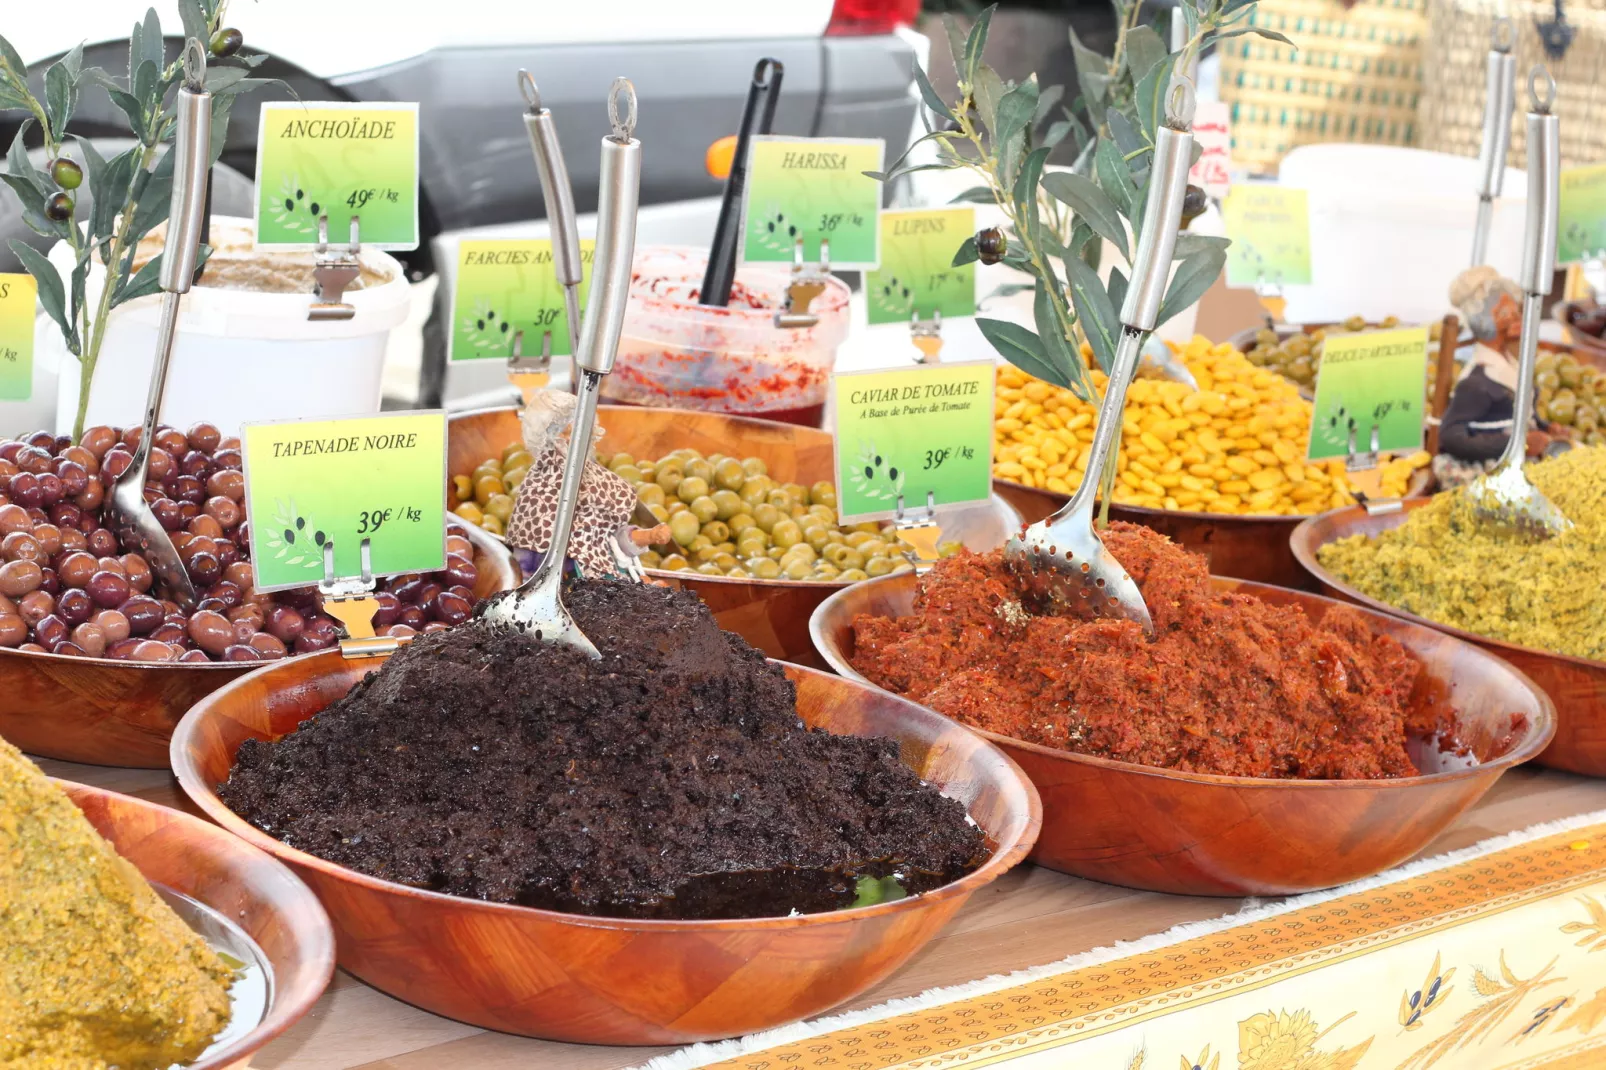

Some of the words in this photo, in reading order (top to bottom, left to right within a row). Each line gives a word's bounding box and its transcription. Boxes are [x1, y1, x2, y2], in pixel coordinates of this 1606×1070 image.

[280, 116, 396, 139] ANCHOÏADE
[781, 152, 848, 170] HARISSA
[346, 187, 376, 209] 49€
[386, 188, 399, 203] kg
[893, 217, 946, 236] LUPINS
[464, 250, 531, 265] FARCIES
[4, 348, 18, 361] kg
[850, 387, 898, 404] CAVIAR
[902, 385, 921, 400] DE
[924, 381, 979, 398] TOMATE
[869, 407, 888, 418] Base
[890, 406, 900, 416] de
[929, 402, 939, 413] de
[941, 400, 971, 412] Tomate
[273, 436, 359, 457] TAPENADE
[363, 433, 417, 450] NOIRE
[923, 447, 951, 470] 39€
[962, 446, 974, 460] kg
[357, 507, 392, 533] 39€
[406, 506, 422, 522] kg
